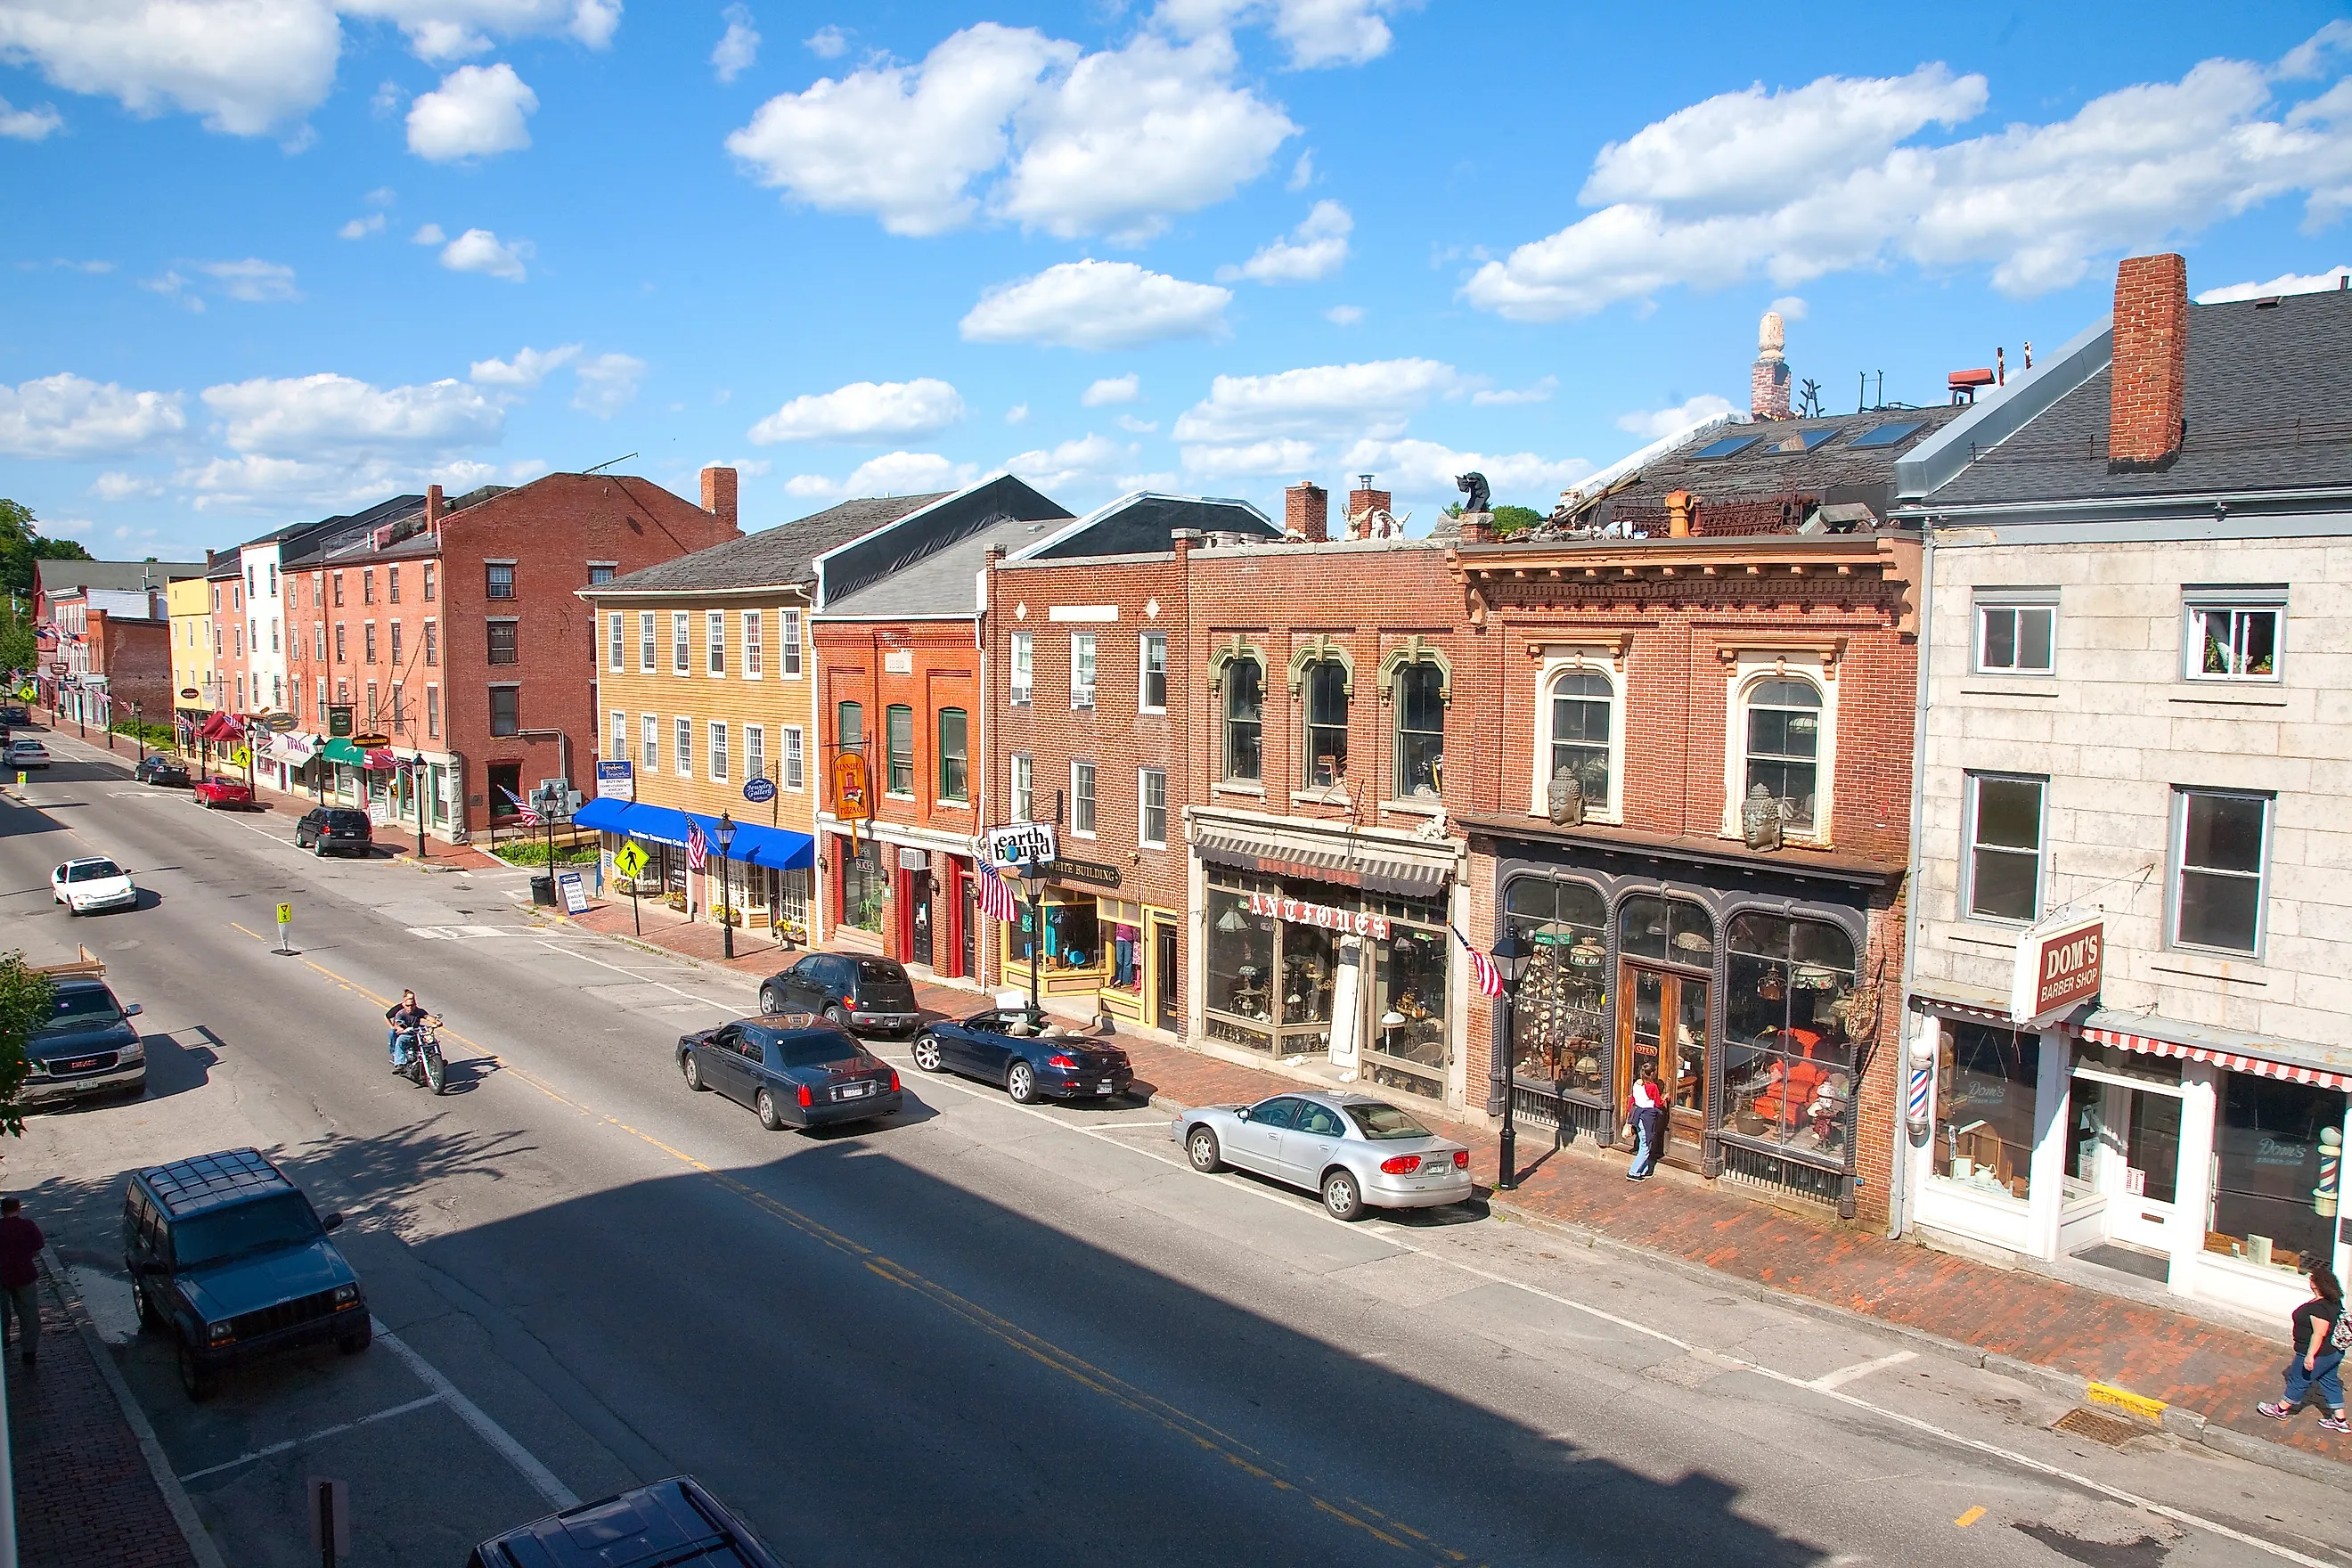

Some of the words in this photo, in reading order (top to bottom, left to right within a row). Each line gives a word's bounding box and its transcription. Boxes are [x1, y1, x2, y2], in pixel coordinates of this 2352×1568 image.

[747, 781, 773, 792] Jewelry
[747, 788, 772, 798] Gallery
[840, 806, 857, 815] PIZZA
[628, 829, 649, 839] Timeless
[649, 833, 672, 845] Treasures
[673, 838, 684, 848] Coin
[998, 827, 1044, 846] earth
[858, 845, 870, 856] OPEN
[993, 837, 1051, 862] bound
[856, 860, 874, 871] SLICES
[1048, 861, 1074, 874] WHITE
[1074, 864, 1115, 882] BUILDING
[1250, 892, 1387, 941] ANTIQUES
[2046, 935, 2098, 980] DOM'S
[2040, 976, 2075, 1003] BARBER
[2075, 968, 2098, 990] SHOP
[1636, 1045, 1654, 1055] OPEN
[1968, 1081, 2005, 1098] Dom's
[2258, 1138, 2307, 1158] Dom's
